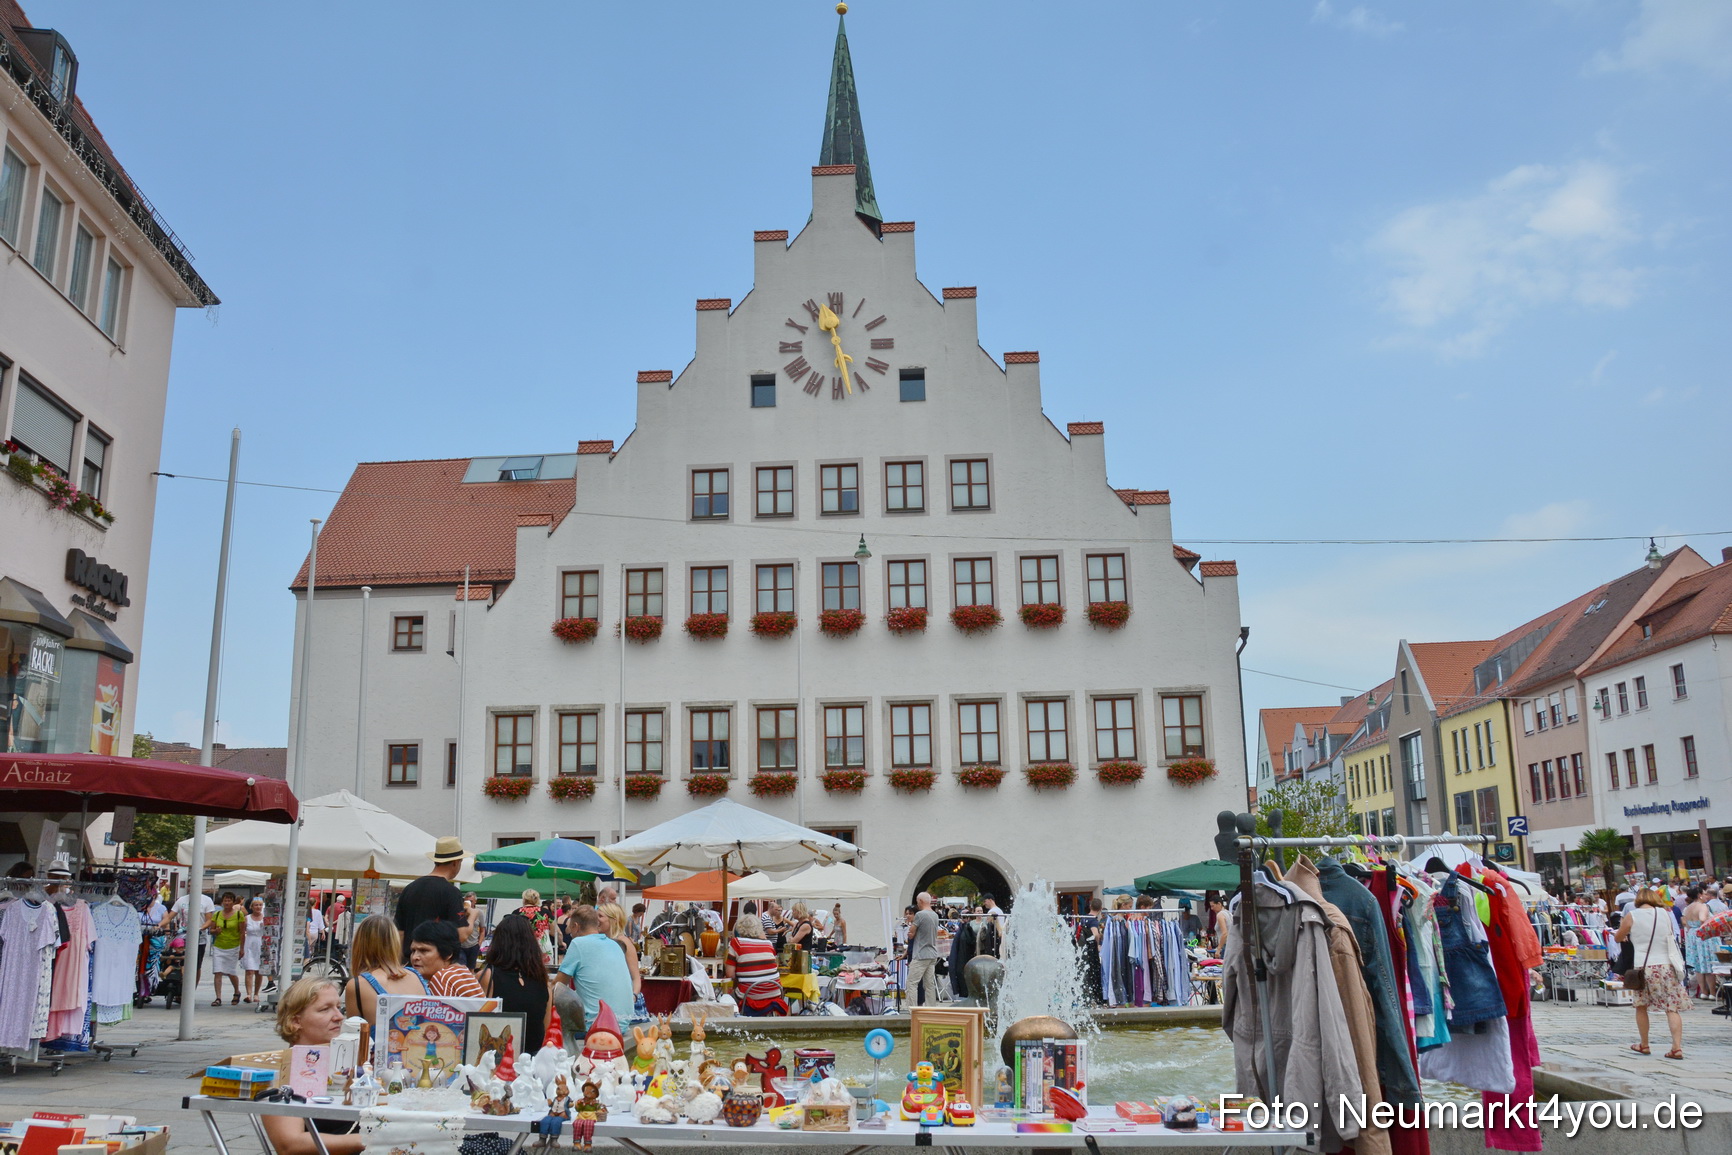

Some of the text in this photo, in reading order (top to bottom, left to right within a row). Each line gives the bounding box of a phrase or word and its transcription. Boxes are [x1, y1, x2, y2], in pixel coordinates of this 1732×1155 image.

[65, 548, 131, 608] RACKL
[3, 761, 72, 784] Achatz
[1623, 796, 1711, 817] Buchhandlung Rupprecht
[404, 1002, 450, 1017] Körper
[445, 1011, 464, 1022] Du
